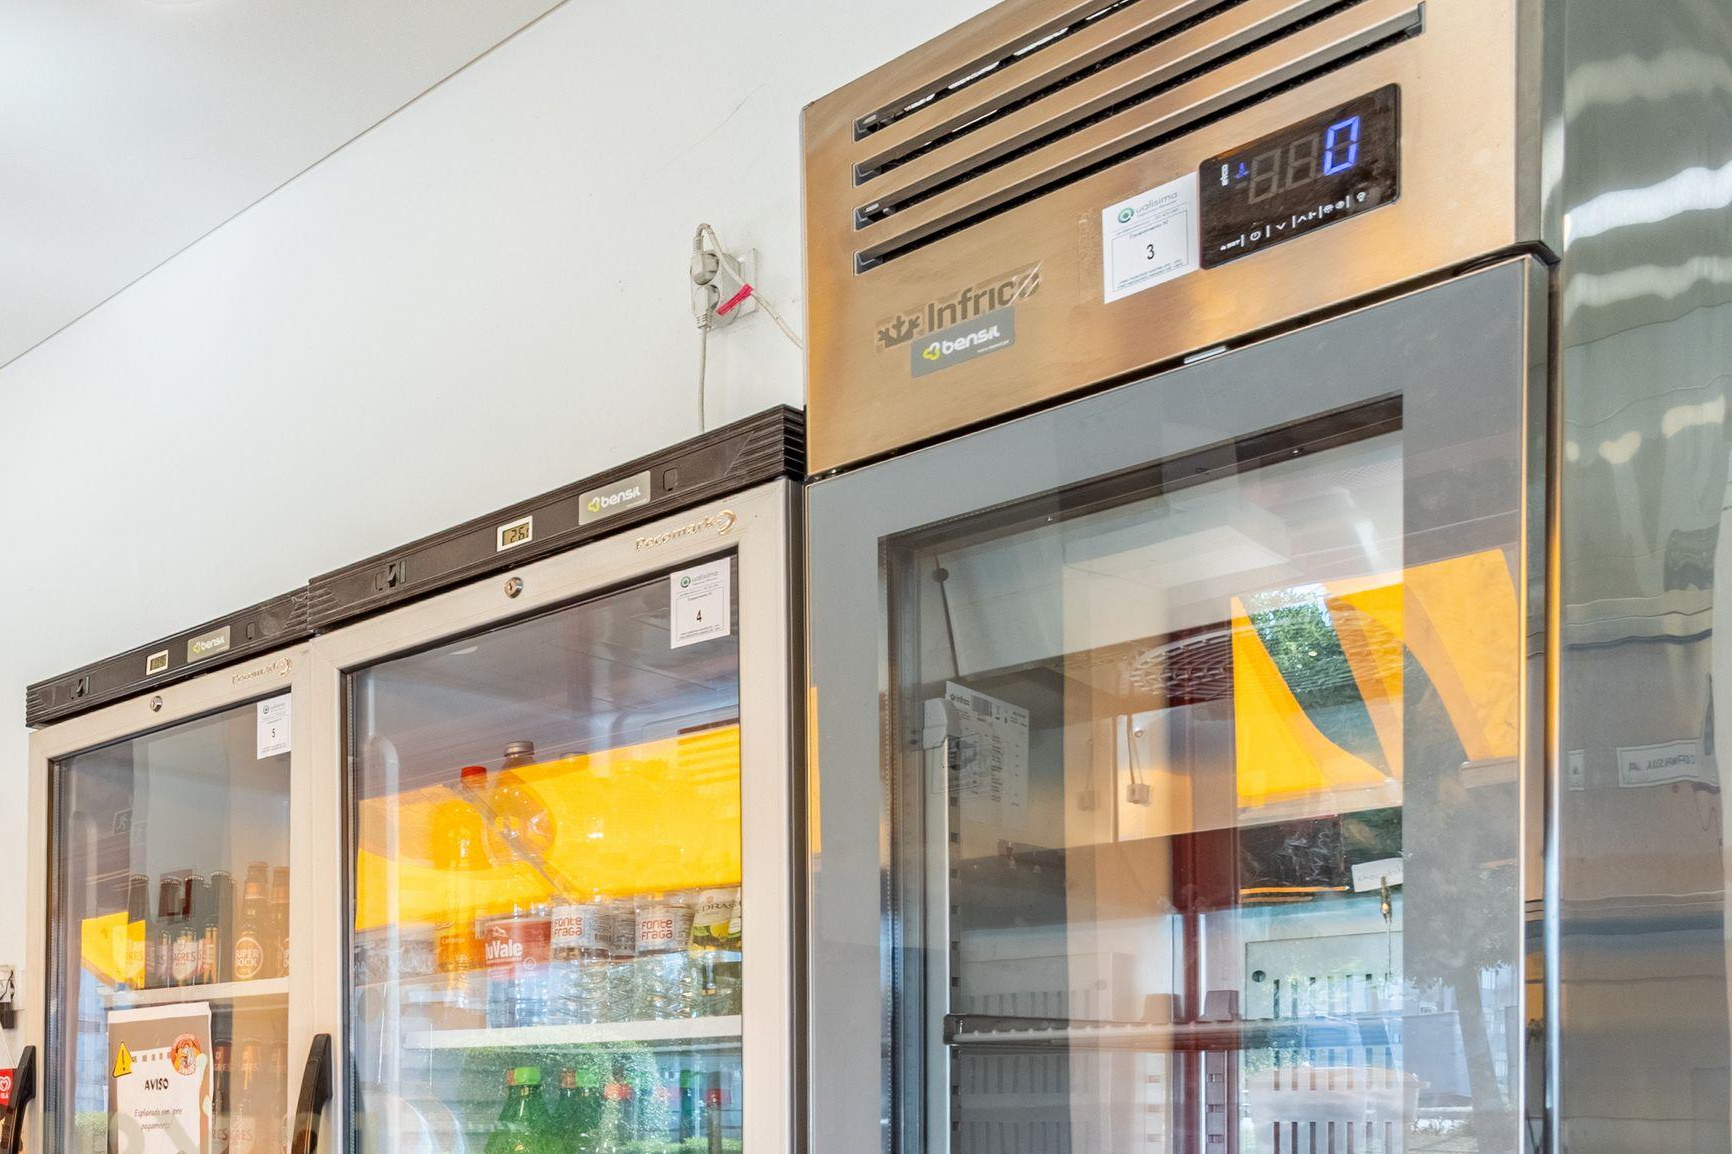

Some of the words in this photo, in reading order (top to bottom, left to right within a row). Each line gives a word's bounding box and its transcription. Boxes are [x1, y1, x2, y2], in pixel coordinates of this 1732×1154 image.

[1323, 115, 1361, 176] 0
[1146, 243, 1156, 260] 3
[928, 272, 1040, 332] Infrico
[695, 608, 703, 623] 4
[271, 728, 276, 738] 5
[144, 1078, 169, 1091] AVISO
